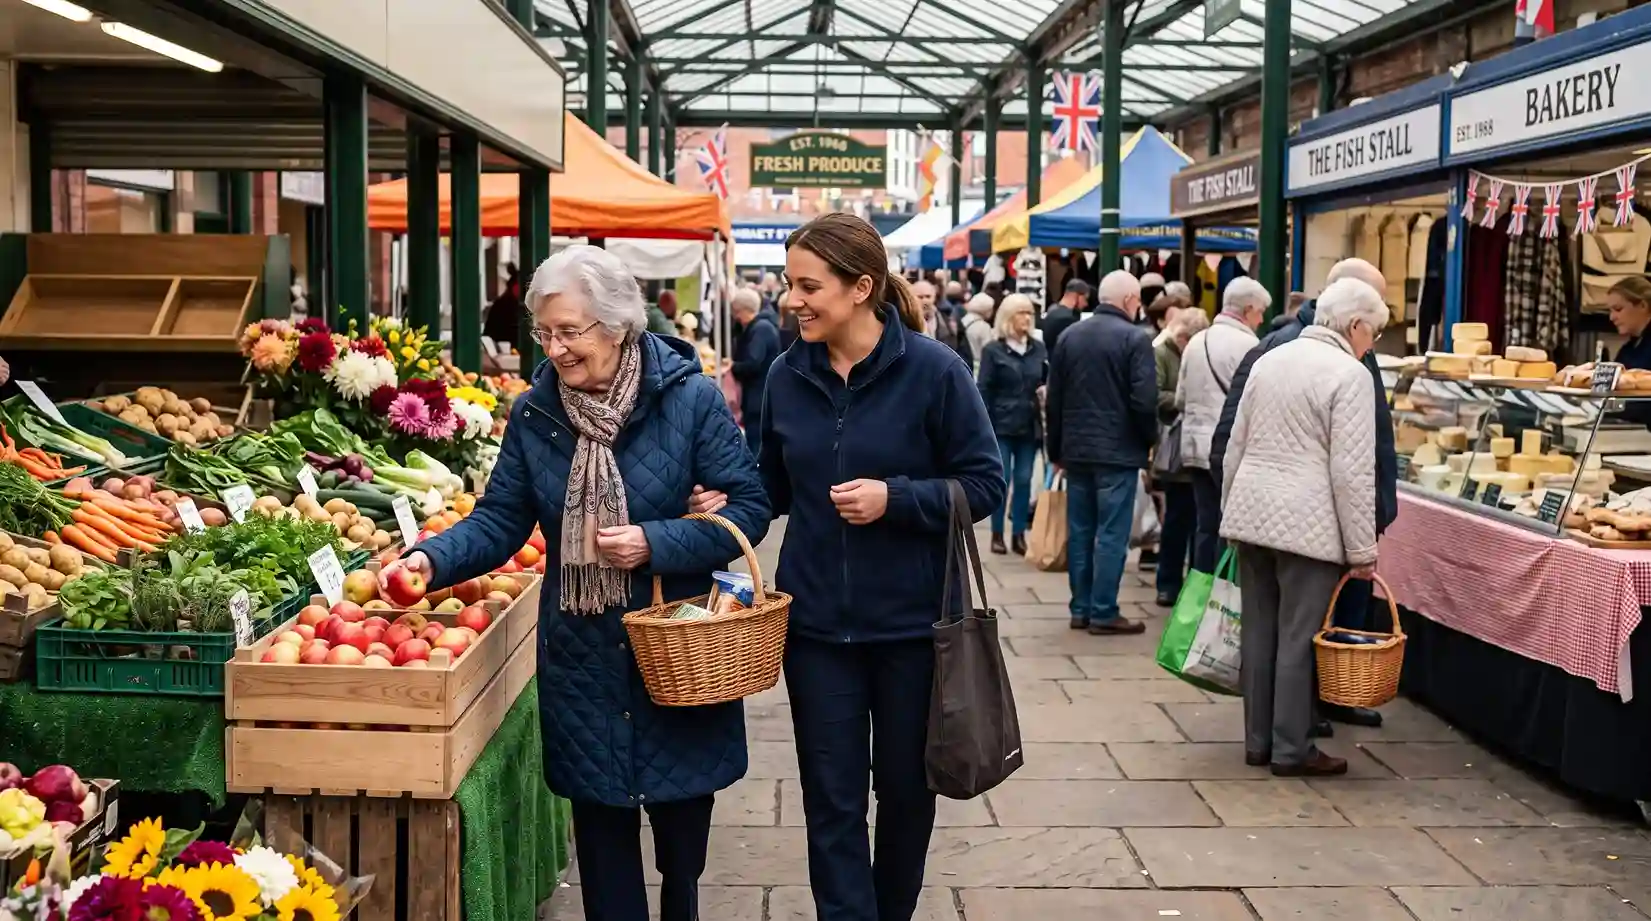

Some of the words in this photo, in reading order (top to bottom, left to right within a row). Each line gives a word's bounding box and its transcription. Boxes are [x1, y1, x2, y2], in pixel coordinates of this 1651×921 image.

[1525, 63, 1621, 127] BAKERY
[789, 136, 816, 152] EST.
[1308, 145, 1332, 177] THE
[1335, 135, 1364, 171] FISH
[1369, 123, 1413, 162] STALL
[754, 156, 804, 172] FRESH
[808, 156, 883, 173] PRODUCE
[1188, 178, 1205, 205] THE
[1205, 172, 1226, 201] FISH
[1226, 165, 1256, 197] STALL
